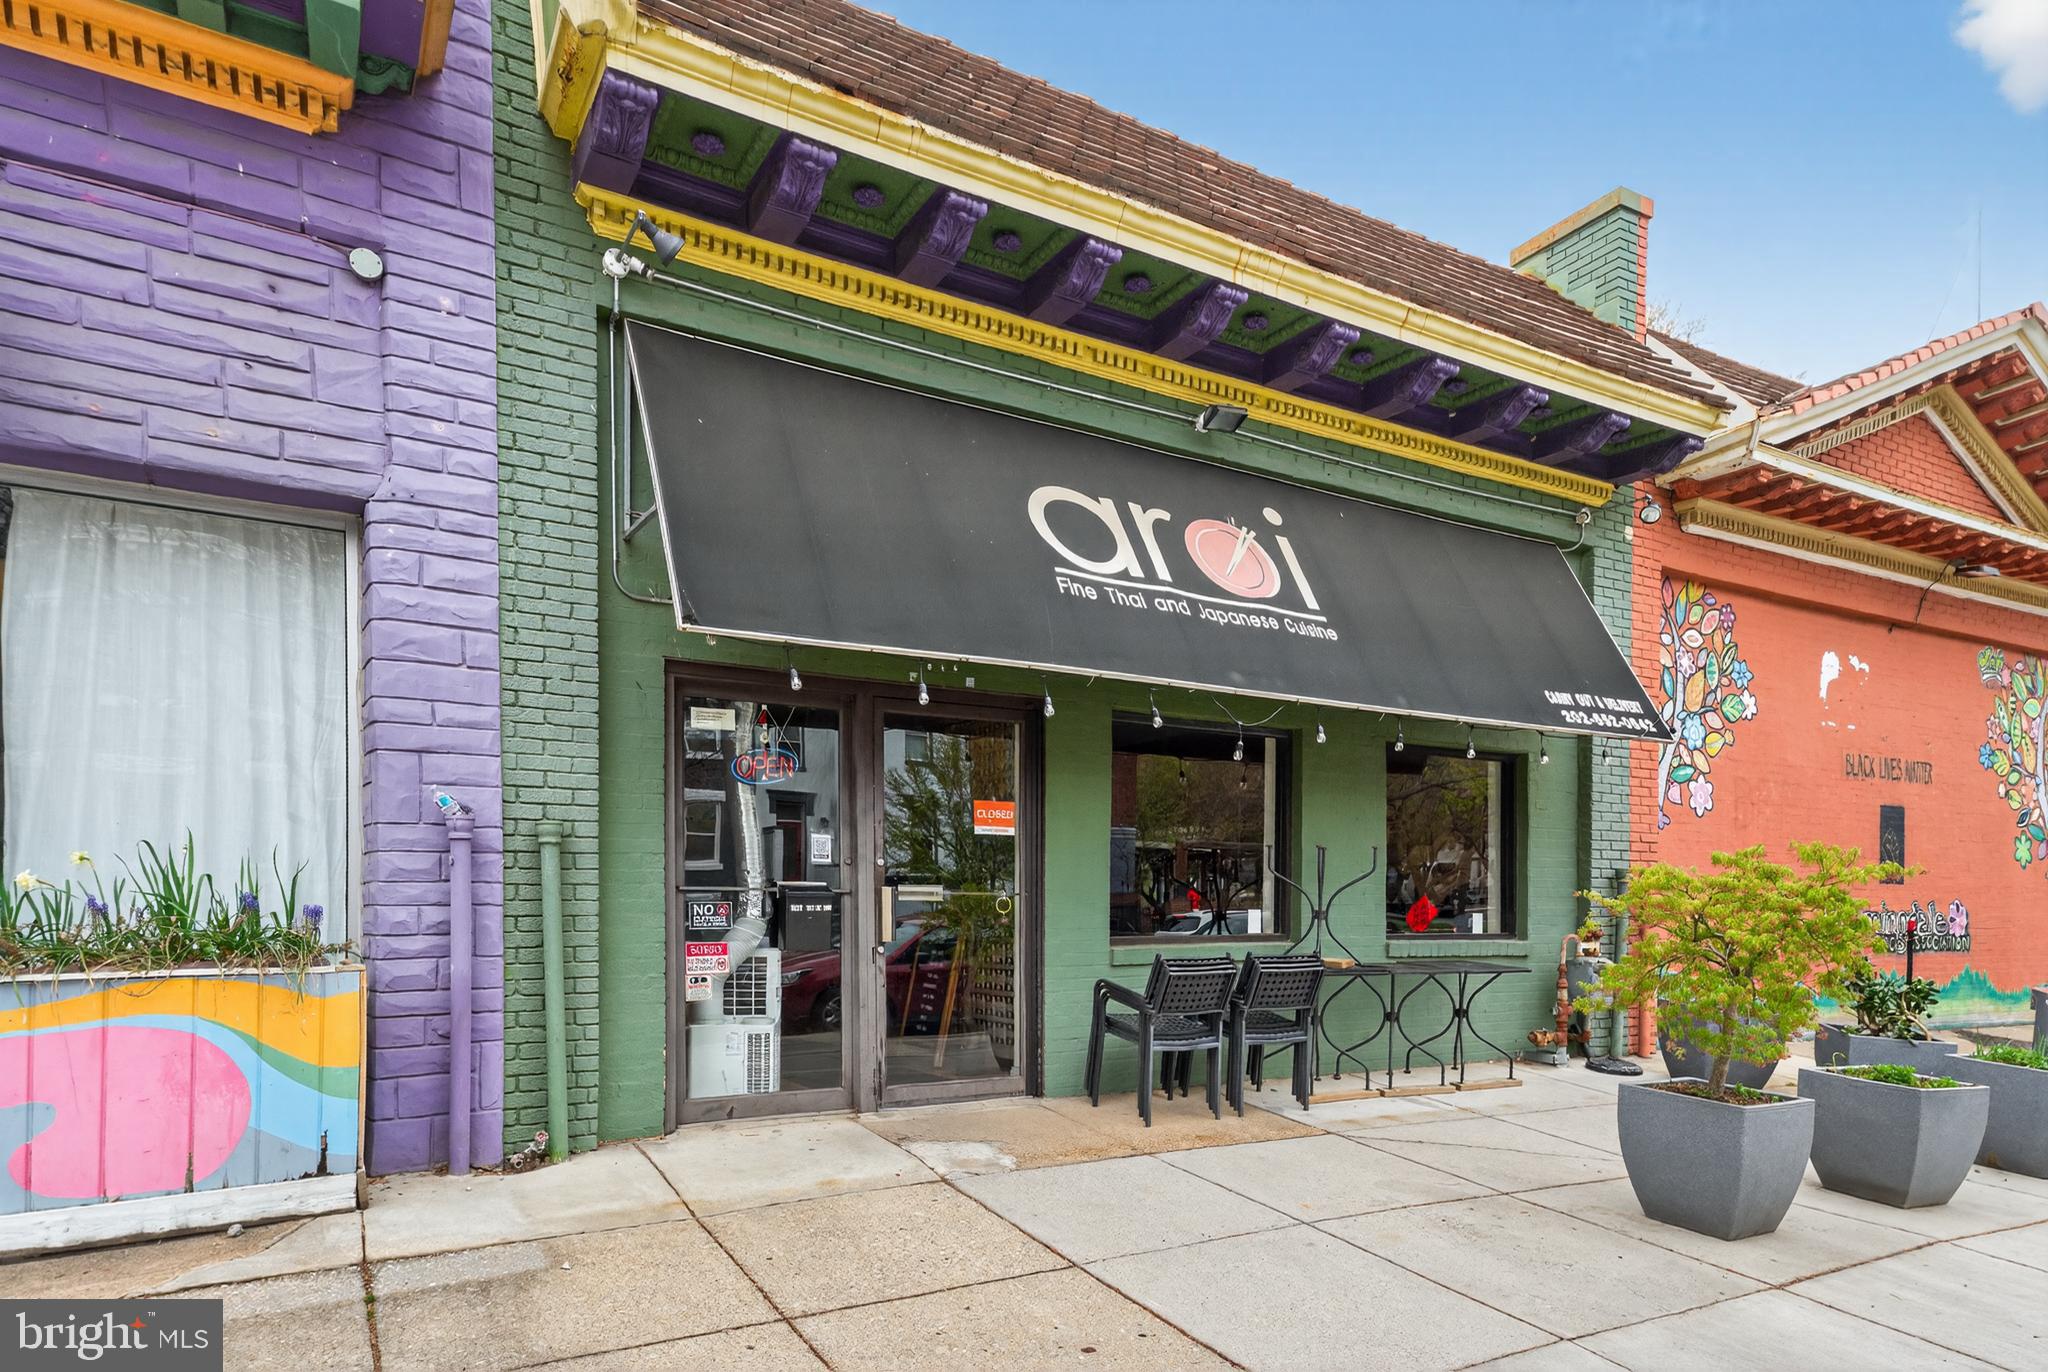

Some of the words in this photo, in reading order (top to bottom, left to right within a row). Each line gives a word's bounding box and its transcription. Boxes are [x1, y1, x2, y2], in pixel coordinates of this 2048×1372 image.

[1028, 485, 1320, 611] aroi
[1056, 576, 1098, 600] Fine
[1104, 586, 1147, 609] Thai
[1155, 597, 1191, 616] and
[1199, 603, 1280, 630] Japanese
[1284, 617, 1338, 641] Cuisine
[737, 755, 794, 779] OPEN
[1845, 753, 1875, 778] BLACK
[1879, 756, 1903, 781] LIVES
[1904, 759, 1933, 785] MATTER
[976, 809, 1014, 819] CLOSED
[693, 904, 714, 916] NO
